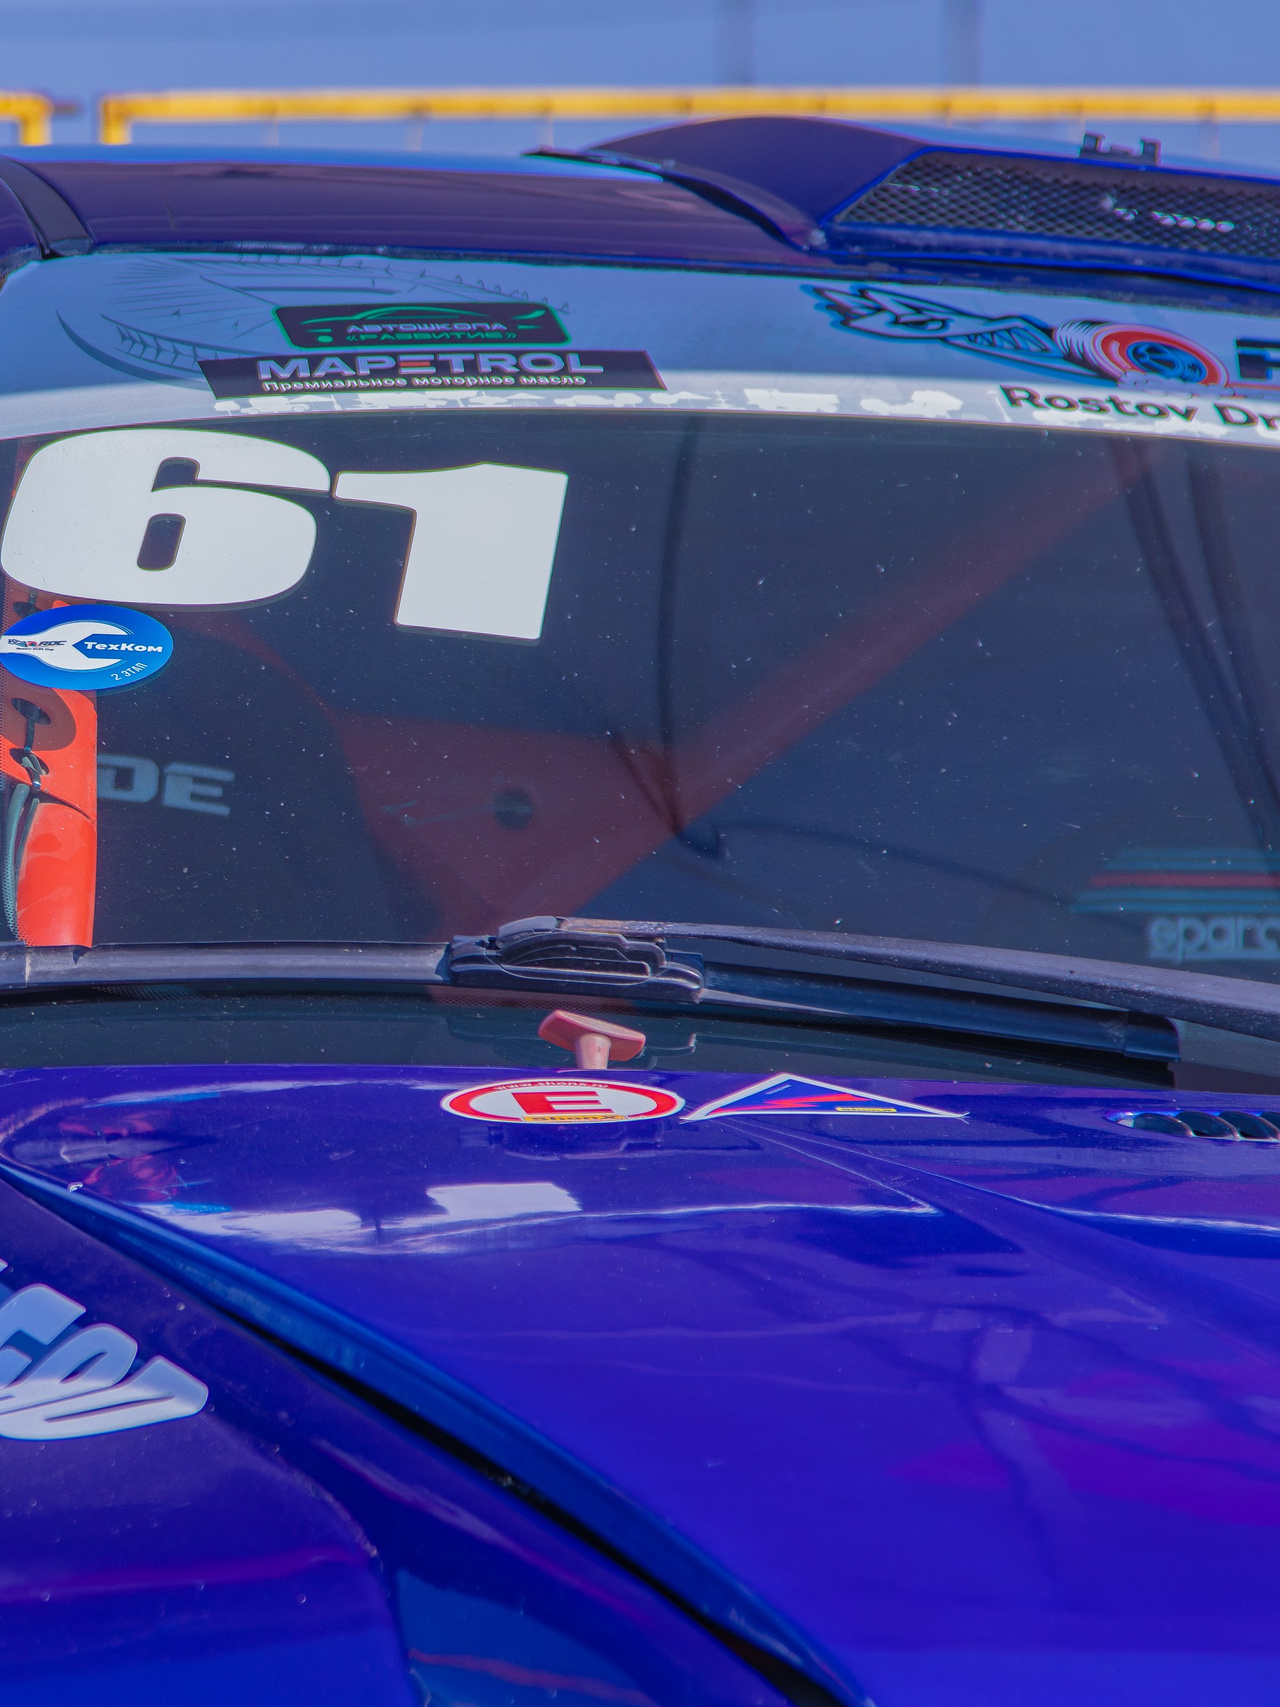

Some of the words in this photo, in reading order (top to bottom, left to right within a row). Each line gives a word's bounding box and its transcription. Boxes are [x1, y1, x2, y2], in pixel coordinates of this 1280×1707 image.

[257, 353, 604, 380] MAPETROL
[262, 376, 408, 393] Премиальное
[412, 375, 516, 387] моторное
[520, 374, 587, 386] масло
[1000, 384, 1199, 422] Rostov
[0, 428, 569, 640] 61
[83, 641, 164, 653] ТехКом
[110, 673, 122, 681] 2
[121, 662, 148, 677] ЭТАП
[511, 1091, 614, 1114] E
